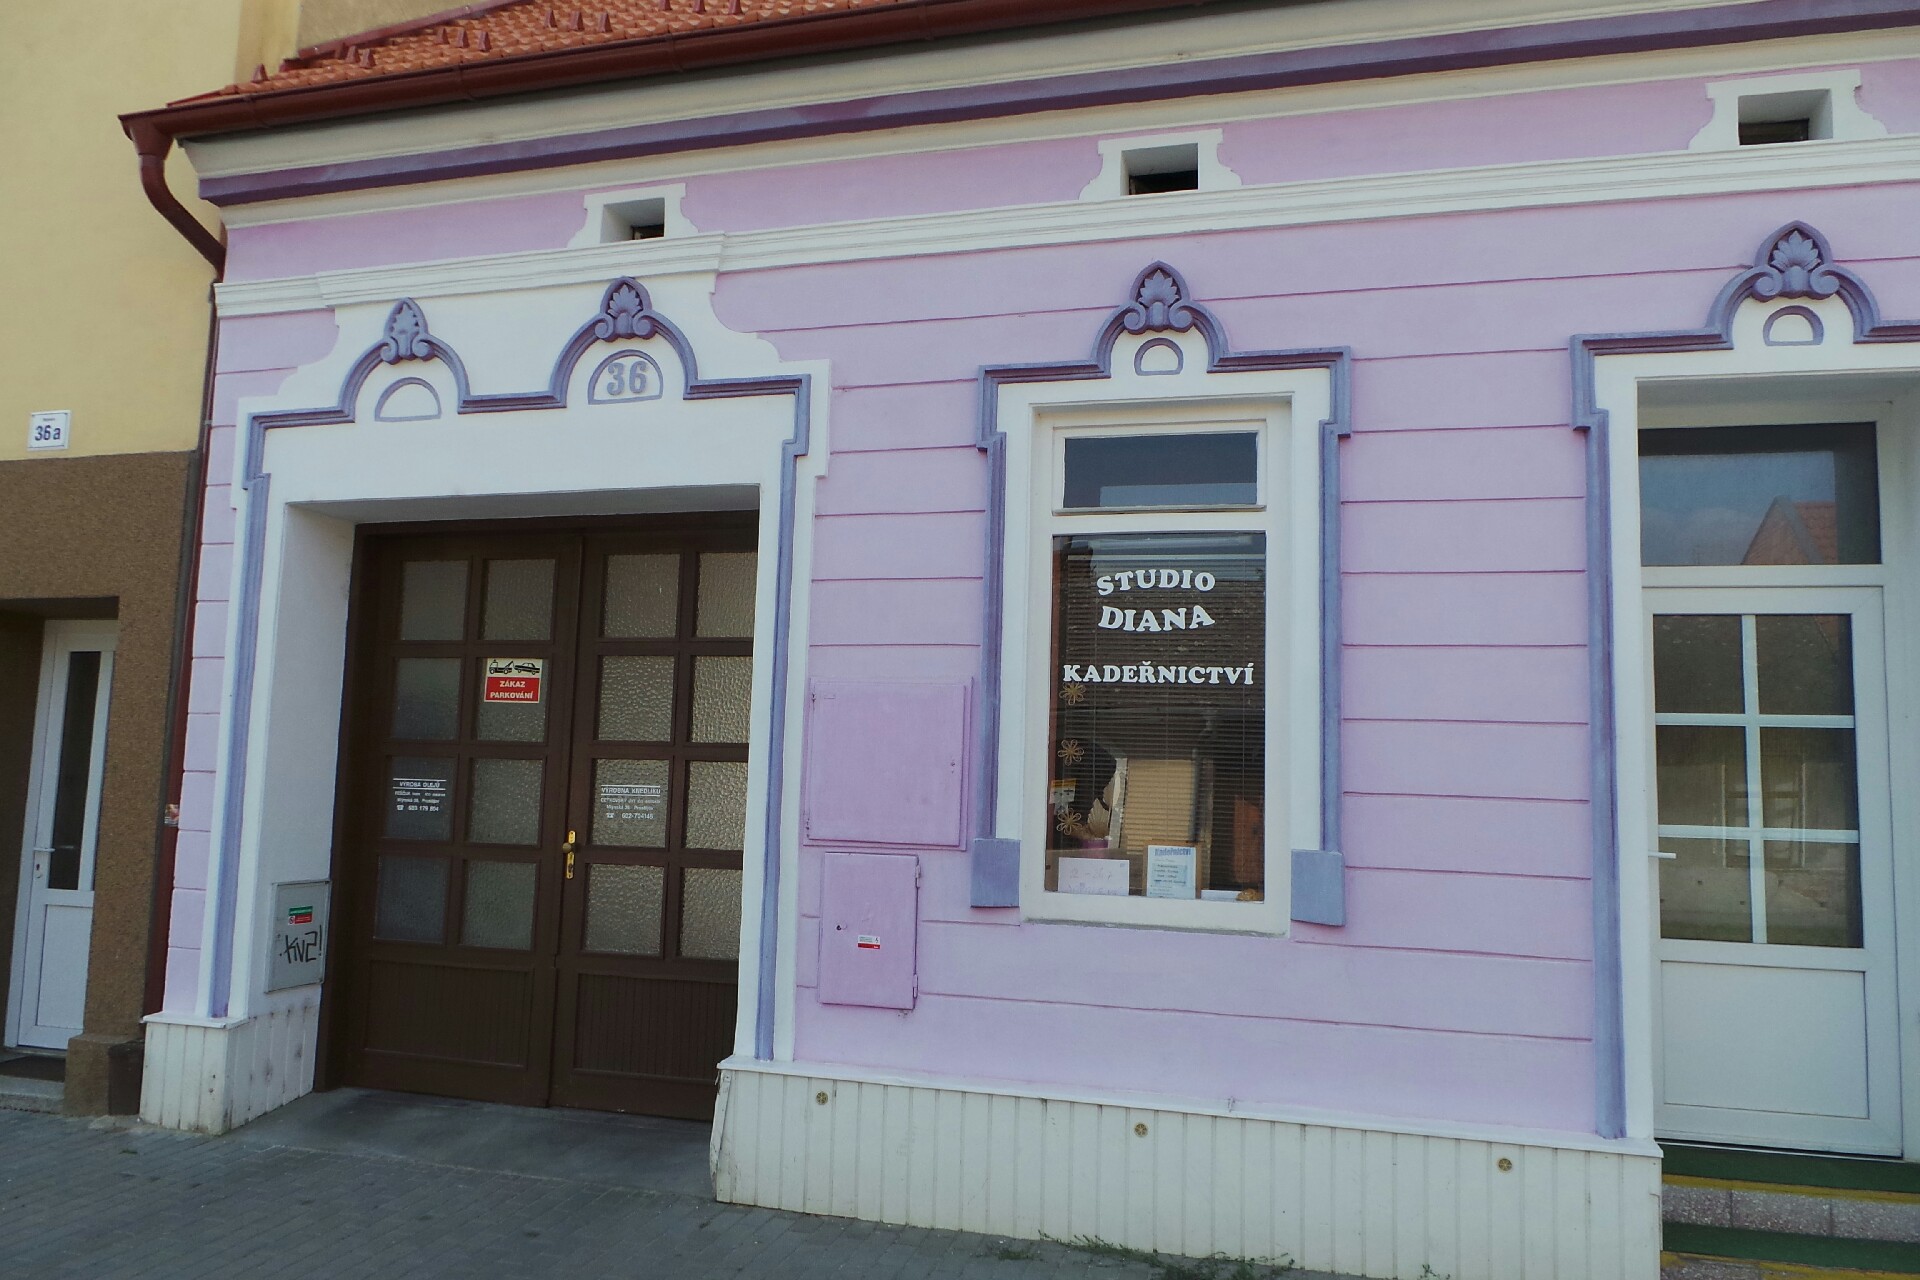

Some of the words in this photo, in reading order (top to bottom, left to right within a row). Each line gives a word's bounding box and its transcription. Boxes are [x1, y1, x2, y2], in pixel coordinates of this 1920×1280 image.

[607, 361, 647, 395] 36
[1096, 569, 1216, 596] STUDIO
[1098, 604, 1216, 632] DIANA
[499, 680, 526, 688] ZÁKAZ
[1063, 661, 1255, 685] KADEŘNICTVÍ
[489, 691, 534, 699] PARKOVÁNÍ
